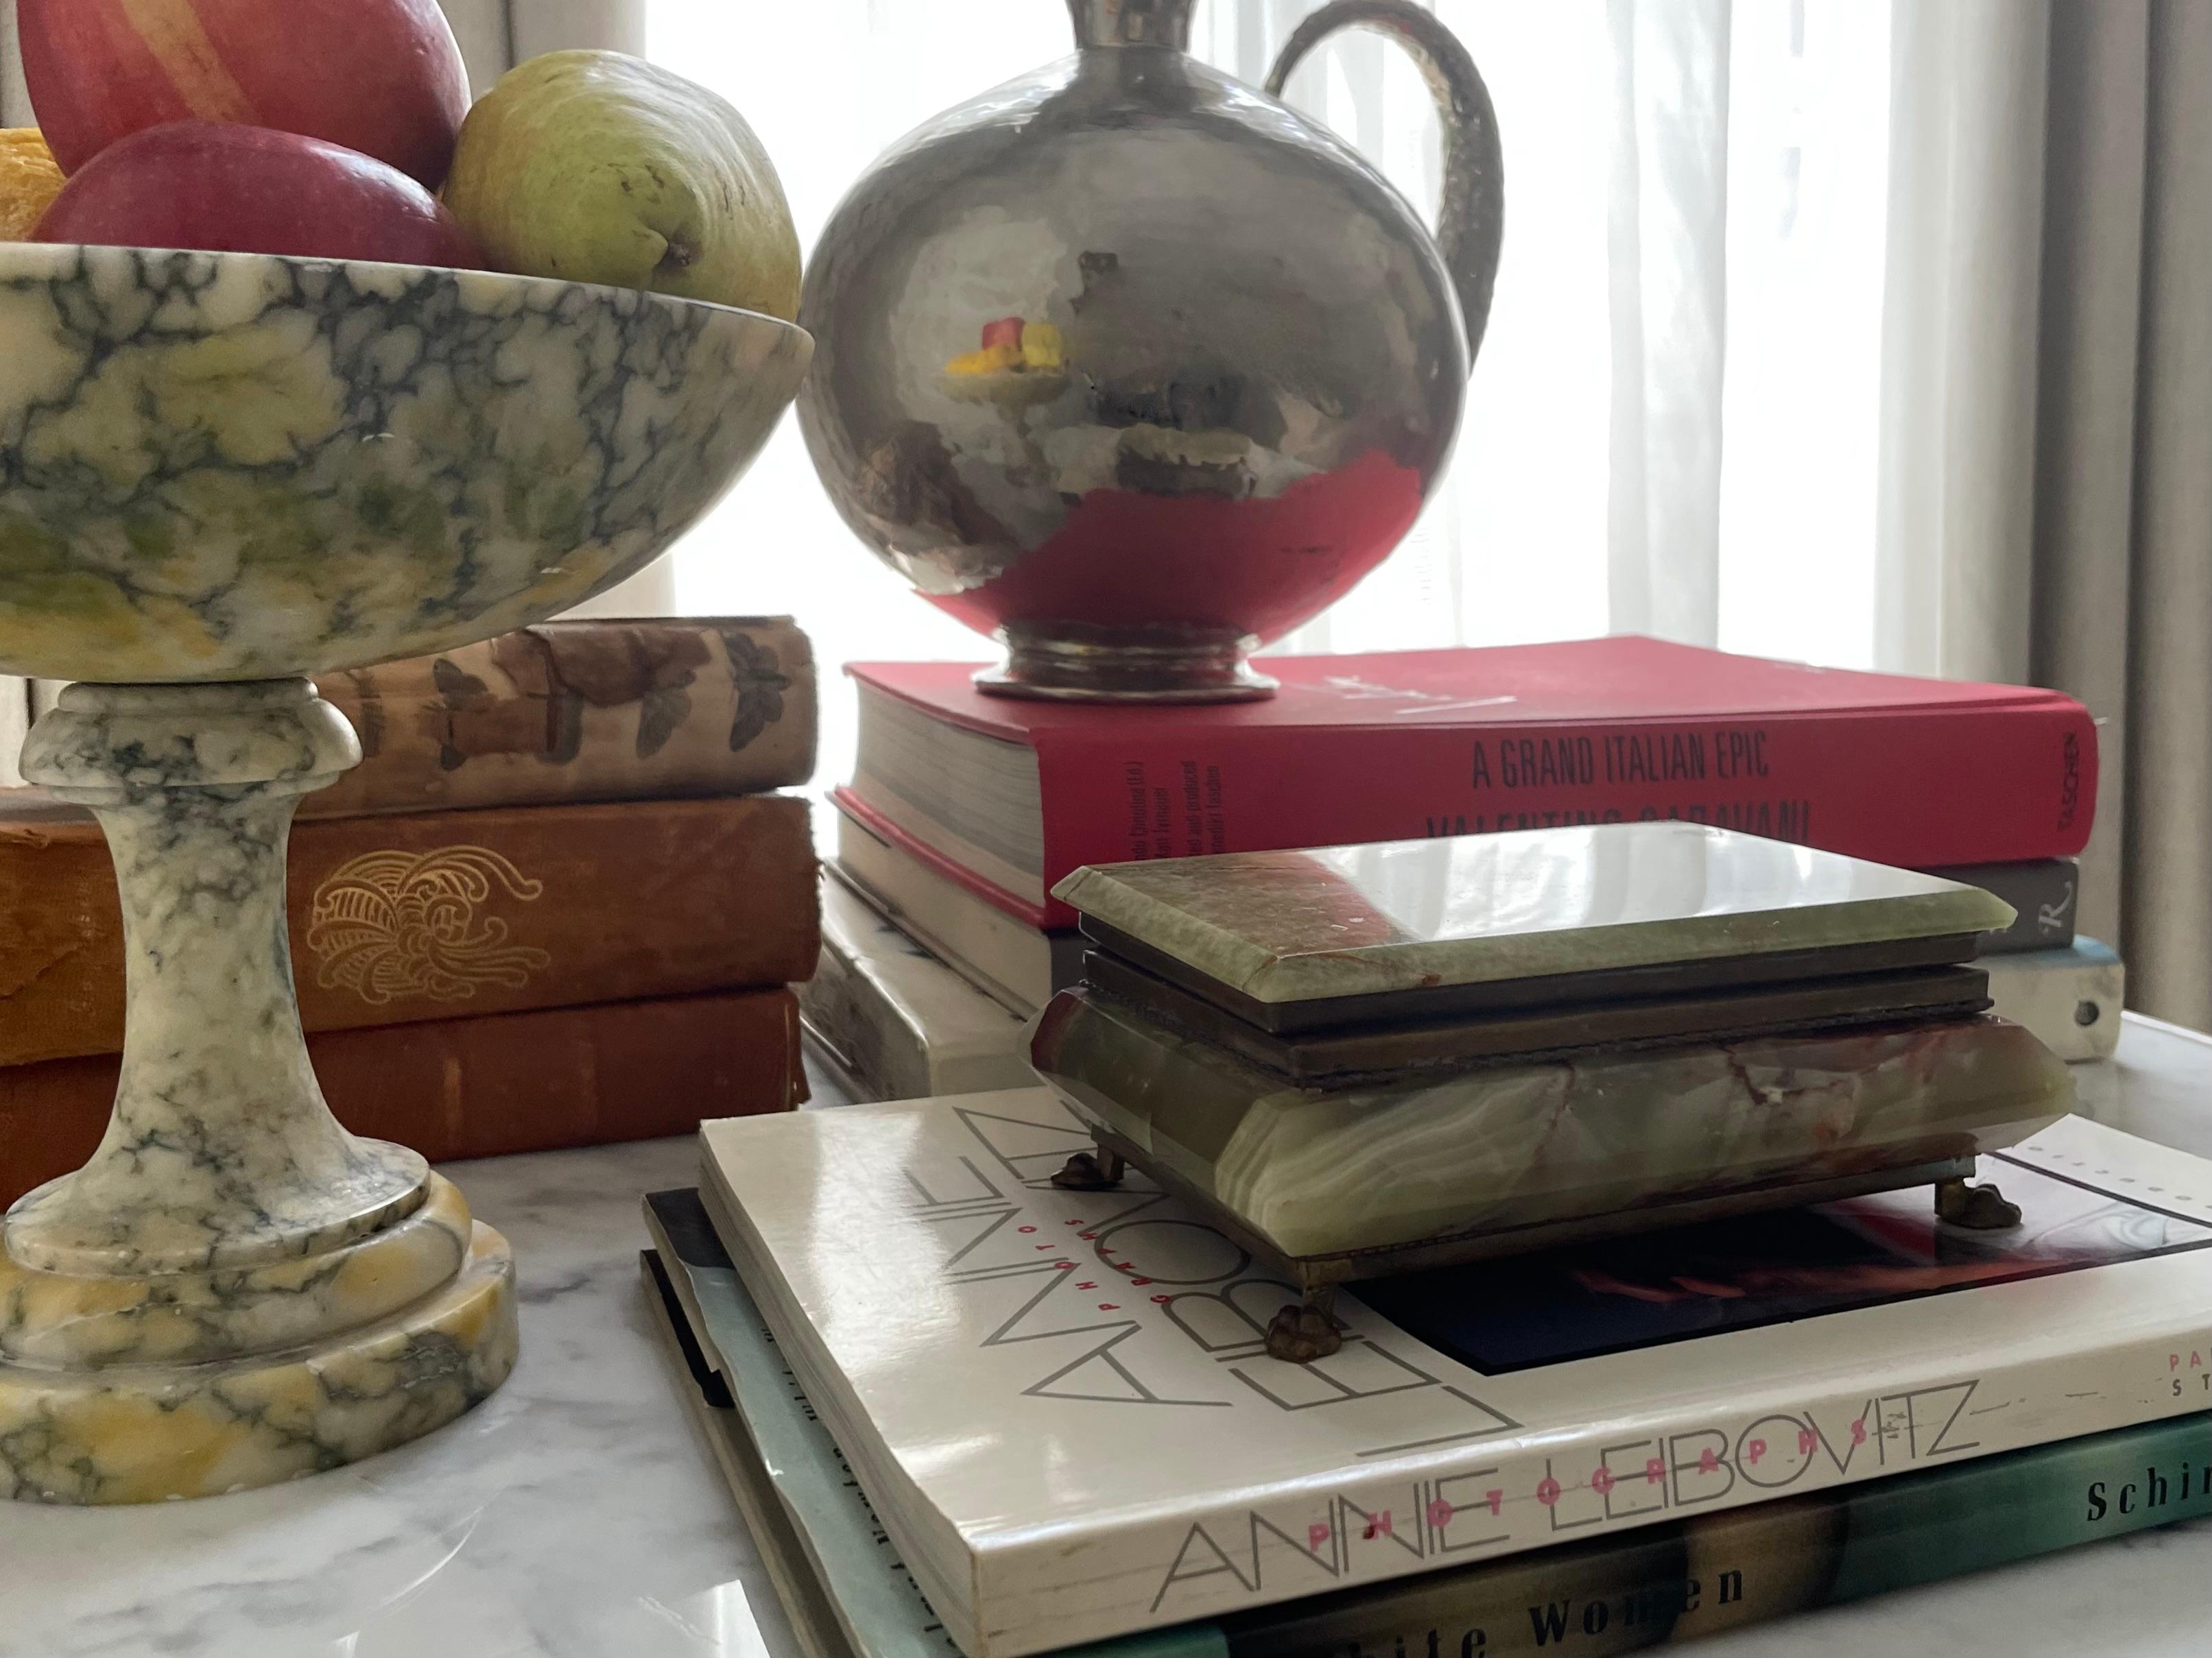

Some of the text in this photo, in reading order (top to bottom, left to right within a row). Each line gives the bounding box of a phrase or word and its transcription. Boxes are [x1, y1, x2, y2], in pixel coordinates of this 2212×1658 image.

[1472, 730, 1770, 789] A GRAND ITALIAN EPIC
[2168, 1347, 2212, 1372] PA
[1149, 1379, 1981, 1614] ANNIE LEIBOVITZ
[1308, 1418, 1867, 1554] PHOTOGRAPHS
